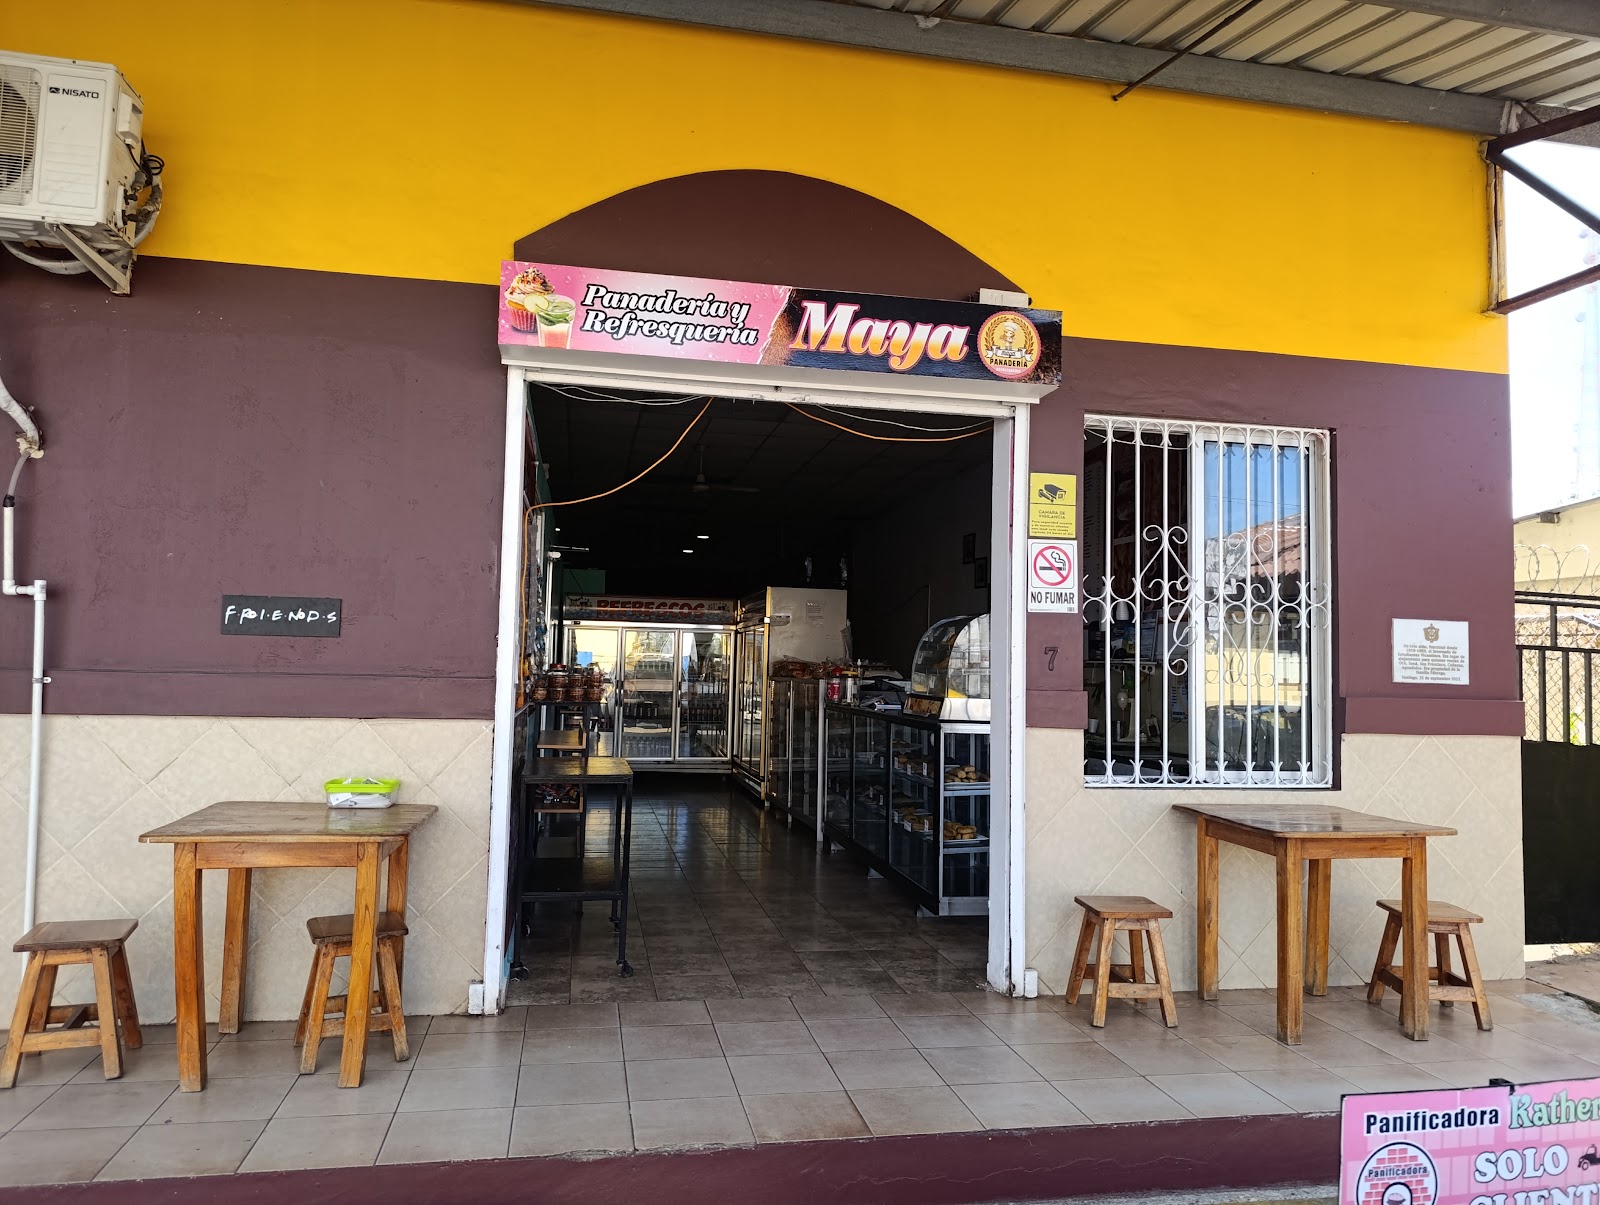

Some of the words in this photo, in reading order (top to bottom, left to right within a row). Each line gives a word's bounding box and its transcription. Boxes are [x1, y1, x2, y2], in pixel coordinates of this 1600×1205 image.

[62, 88, 99, 98] NISATO
[581, 284, 727, 318] Panadería
[730, 301, 751, 324] y
[581, 309, 759, 345] Refresquería
[788, 300, 970, 372] Maya
[1030, 591, 1042, 604] NO
[1045, 591, 1075, 604] FUMAR
[1044, 646, 1059, 671] 7
[1365, 1108, 1499, 1134] Panificadora
[1369, 1166, 1427, 1177] Panificadora
[1474, 1144, 1569, 1183] SOLO
